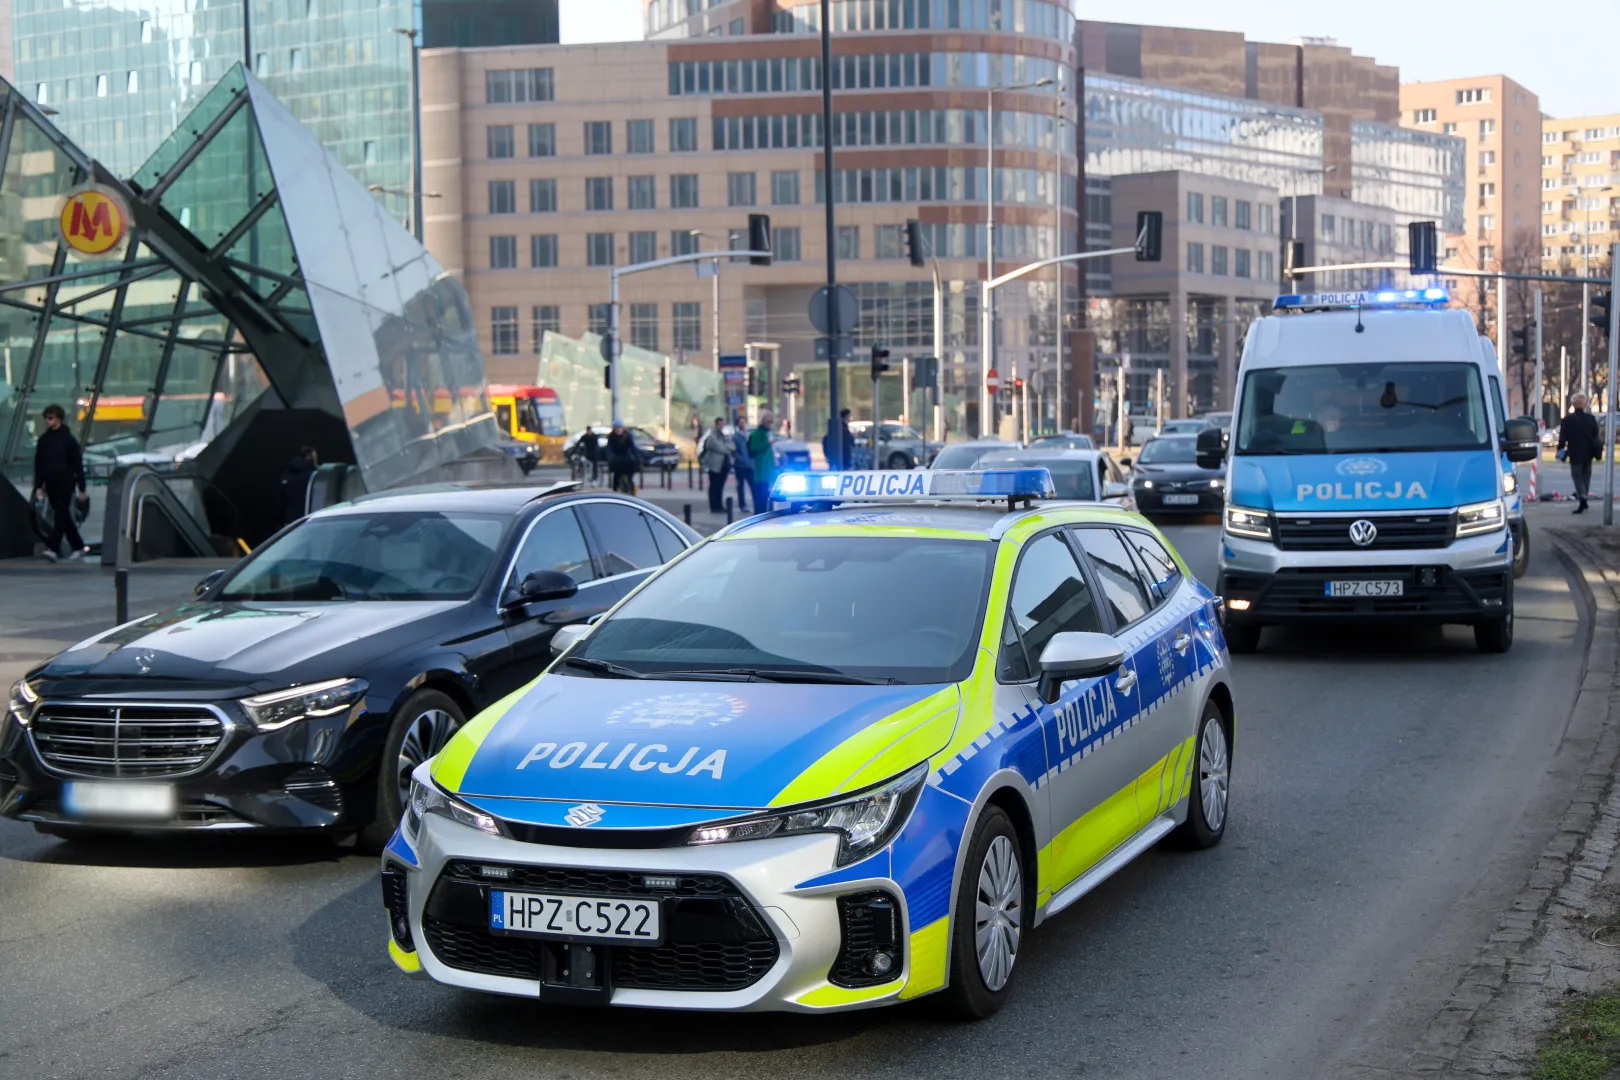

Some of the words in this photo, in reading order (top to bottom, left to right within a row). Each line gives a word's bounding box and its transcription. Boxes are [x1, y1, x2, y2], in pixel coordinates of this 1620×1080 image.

[1321, 293, 1366, 304] POLICJA
[839, 473, 925, 496] POLICJA
[1296, 481, 1428, 501] POLICJA
[1333, 581, 1360, 596] HPZ
[1365, 581, 1400, 595] C573
[1053, 678, 1118, 754] POLICJA
[515, 742, 728, 780] POLICJA
[493, 914, 503, 923] PL
[509, 895, 563, 930] HPZ
[575, 901, 651, 936] C522
